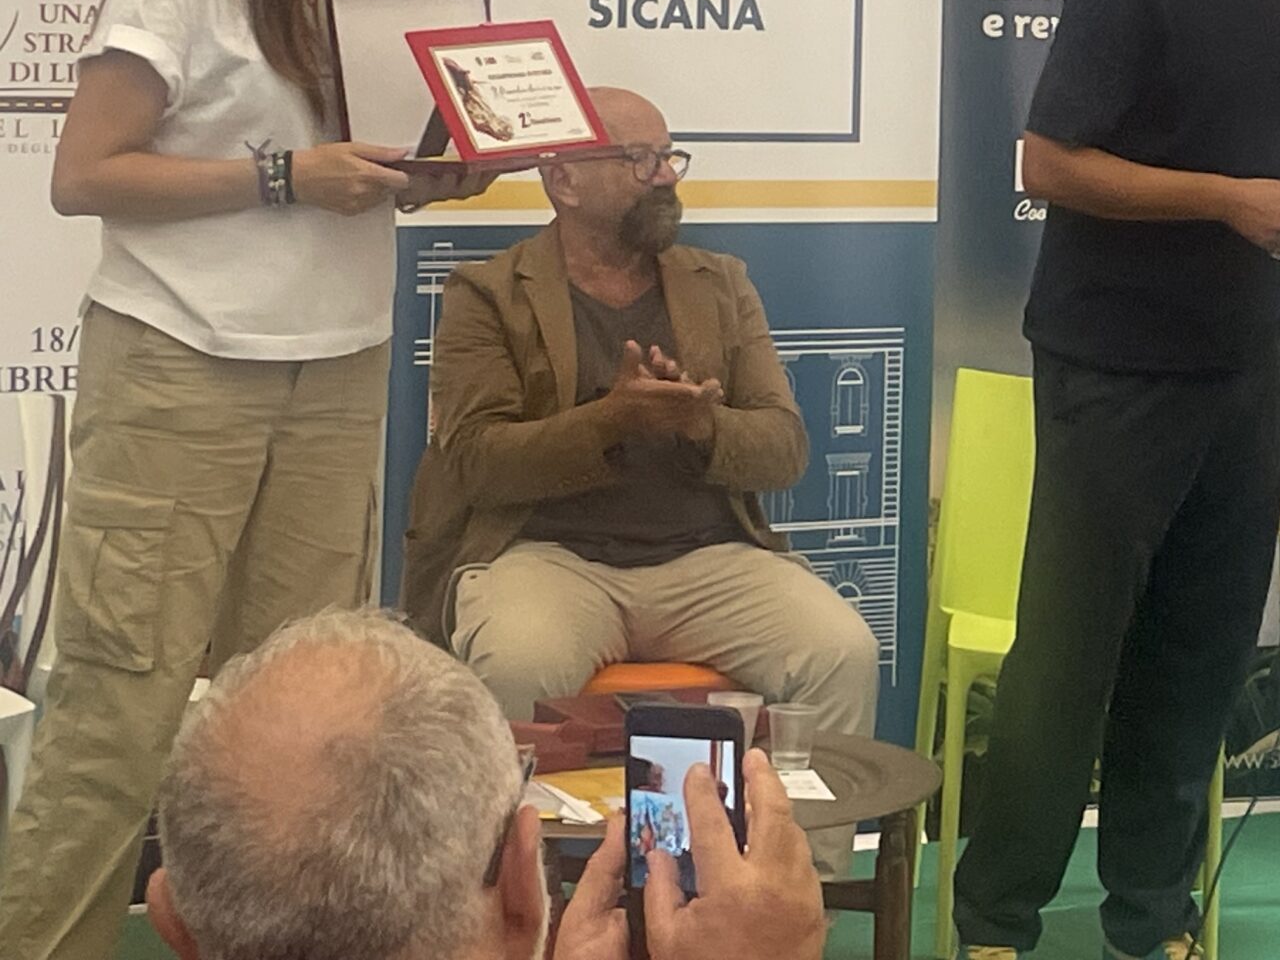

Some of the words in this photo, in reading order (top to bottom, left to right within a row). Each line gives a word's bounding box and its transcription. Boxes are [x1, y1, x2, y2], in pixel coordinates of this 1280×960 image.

[39, 2, 99, 25] UNA
[982, 13, 1005, 38] e
[9, 61, 41, 83] DI
[50, 62, 79, 84] LI
[0, 364, 80, 394] BRE
